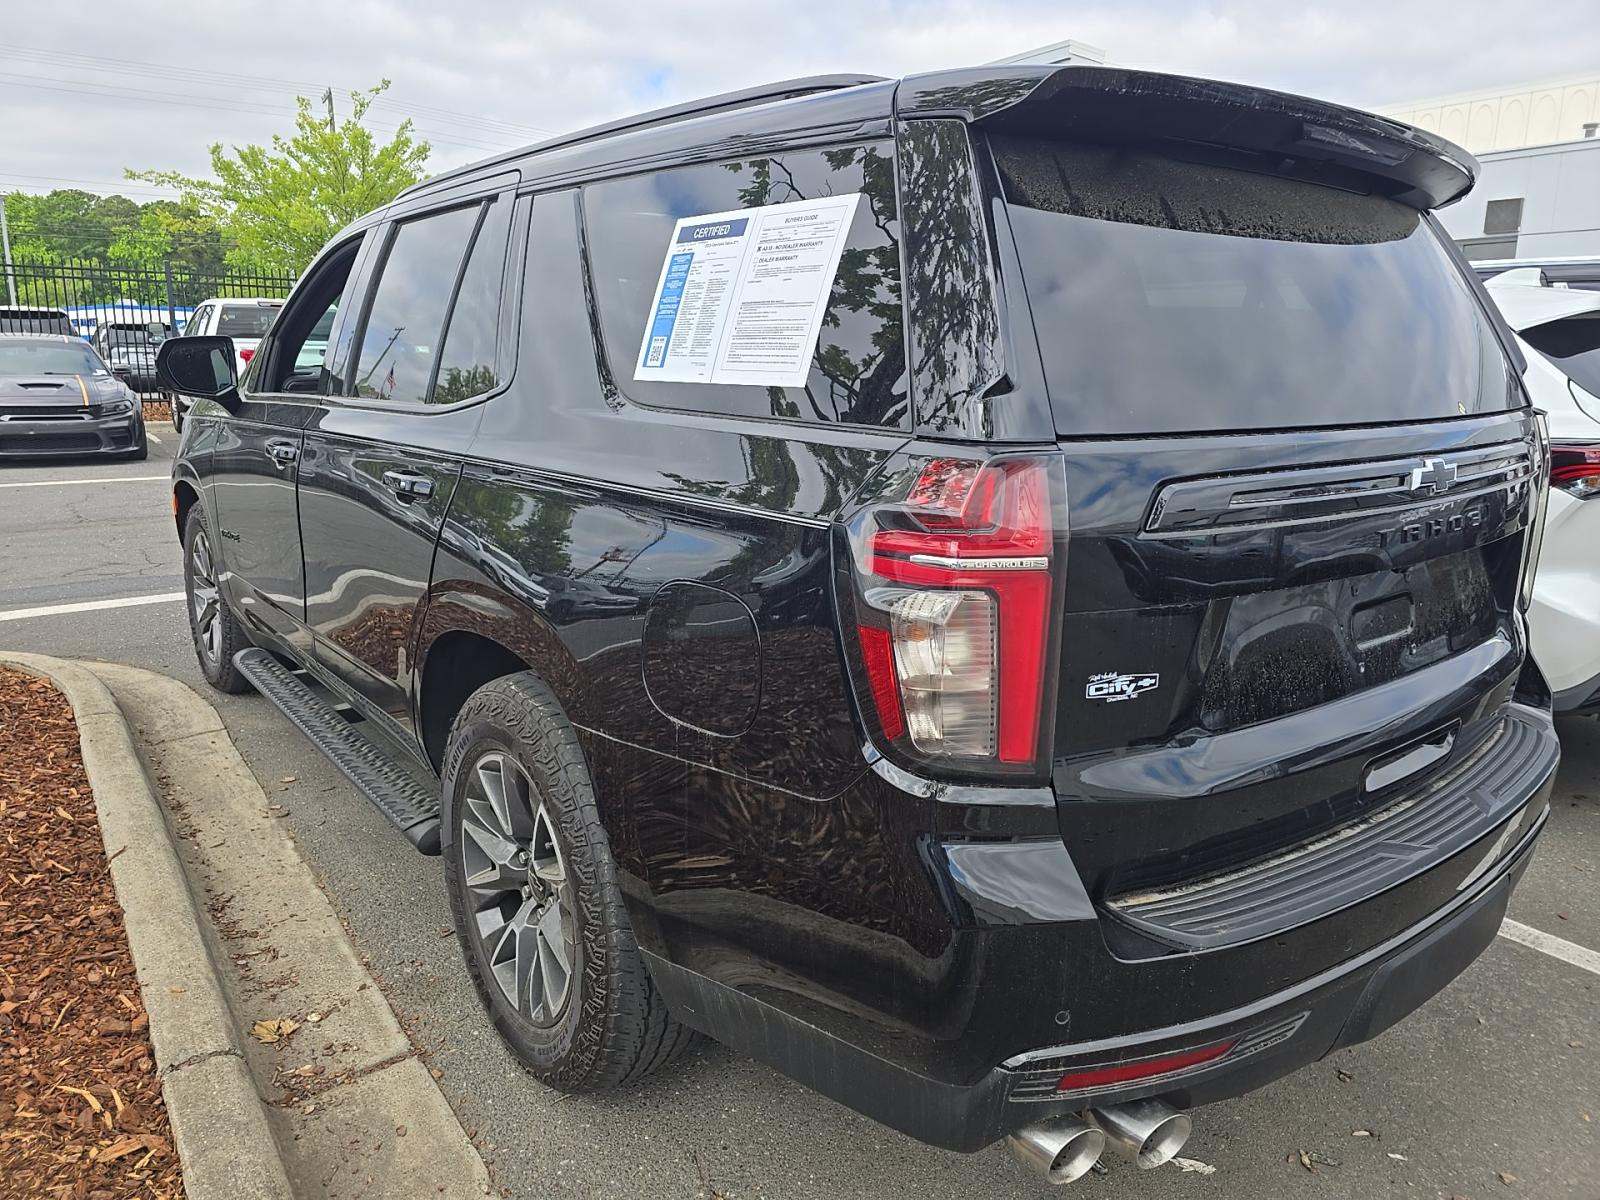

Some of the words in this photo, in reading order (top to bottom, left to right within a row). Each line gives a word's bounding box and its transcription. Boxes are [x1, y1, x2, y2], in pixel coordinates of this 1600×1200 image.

[803, 214, 819, 222] GUIDE
[693, 224, 731, 239] CERTIFIED
[799, 240, 823, 248] WARRANTY
[775, 254, 799, 262] WARRANTY
[1376, 509, 1481, 548] TAHOE
[975, 560, 1034, 568] CHEVROLET
